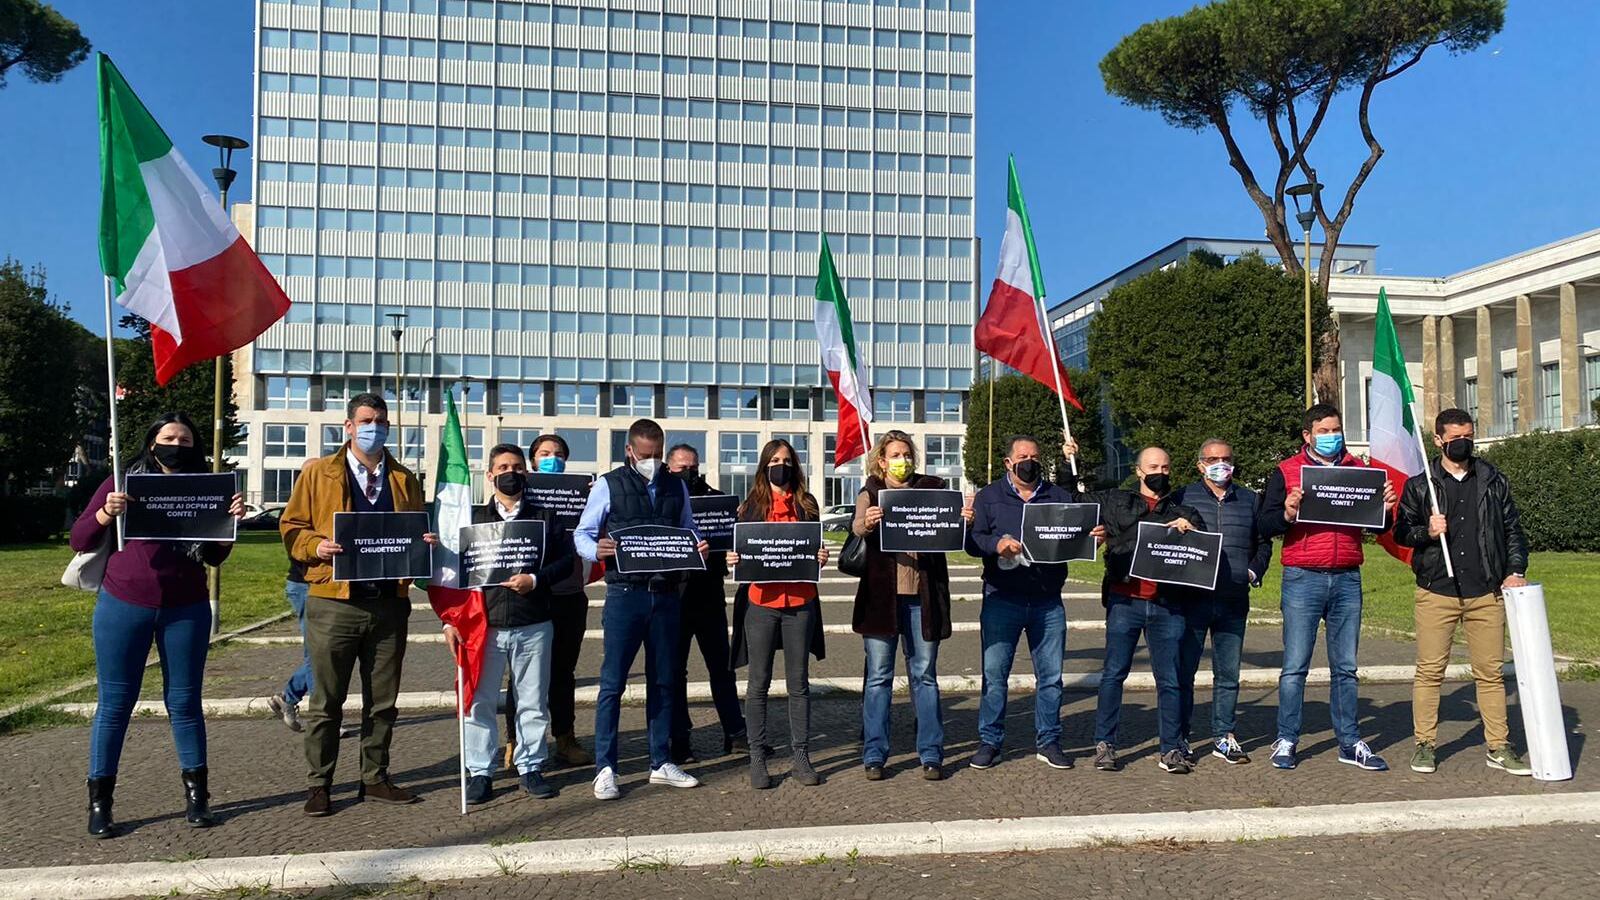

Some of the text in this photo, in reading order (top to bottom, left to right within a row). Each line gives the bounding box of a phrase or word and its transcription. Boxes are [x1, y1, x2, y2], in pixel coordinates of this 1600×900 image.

[918, 506, 939, 514] pietosi
[1153, 544, 1187, 552] COMMERCIO
[1188, 546, 1209, 556] MUORE
